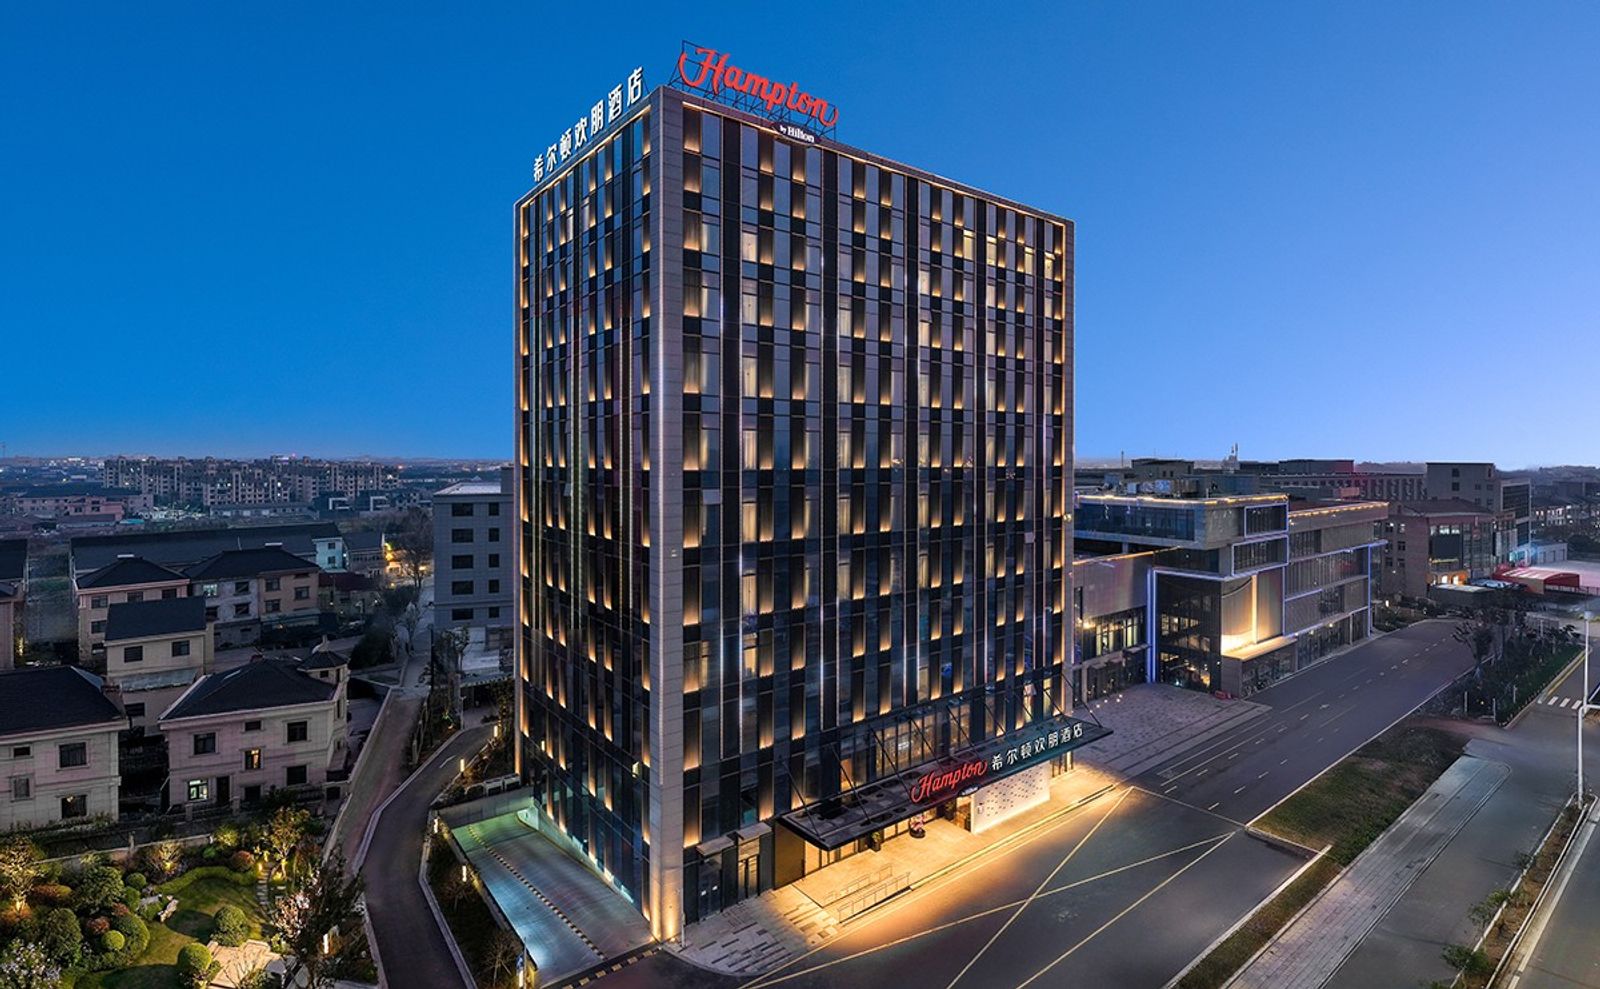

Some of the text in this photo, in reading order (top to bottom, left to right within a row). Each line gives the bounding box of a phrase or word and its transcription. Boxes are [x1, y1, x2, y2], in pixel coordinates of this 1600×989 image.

[679, 47, 839, 127] Hampton
[532, 66, 645, 182] 希尔顿欢朋酒店
[787, 126, 815, 143] Hilton
[991, 722, 1083, 771] 希尔顿欢朋酒店
[910, 760, 988, 804] Hampton
